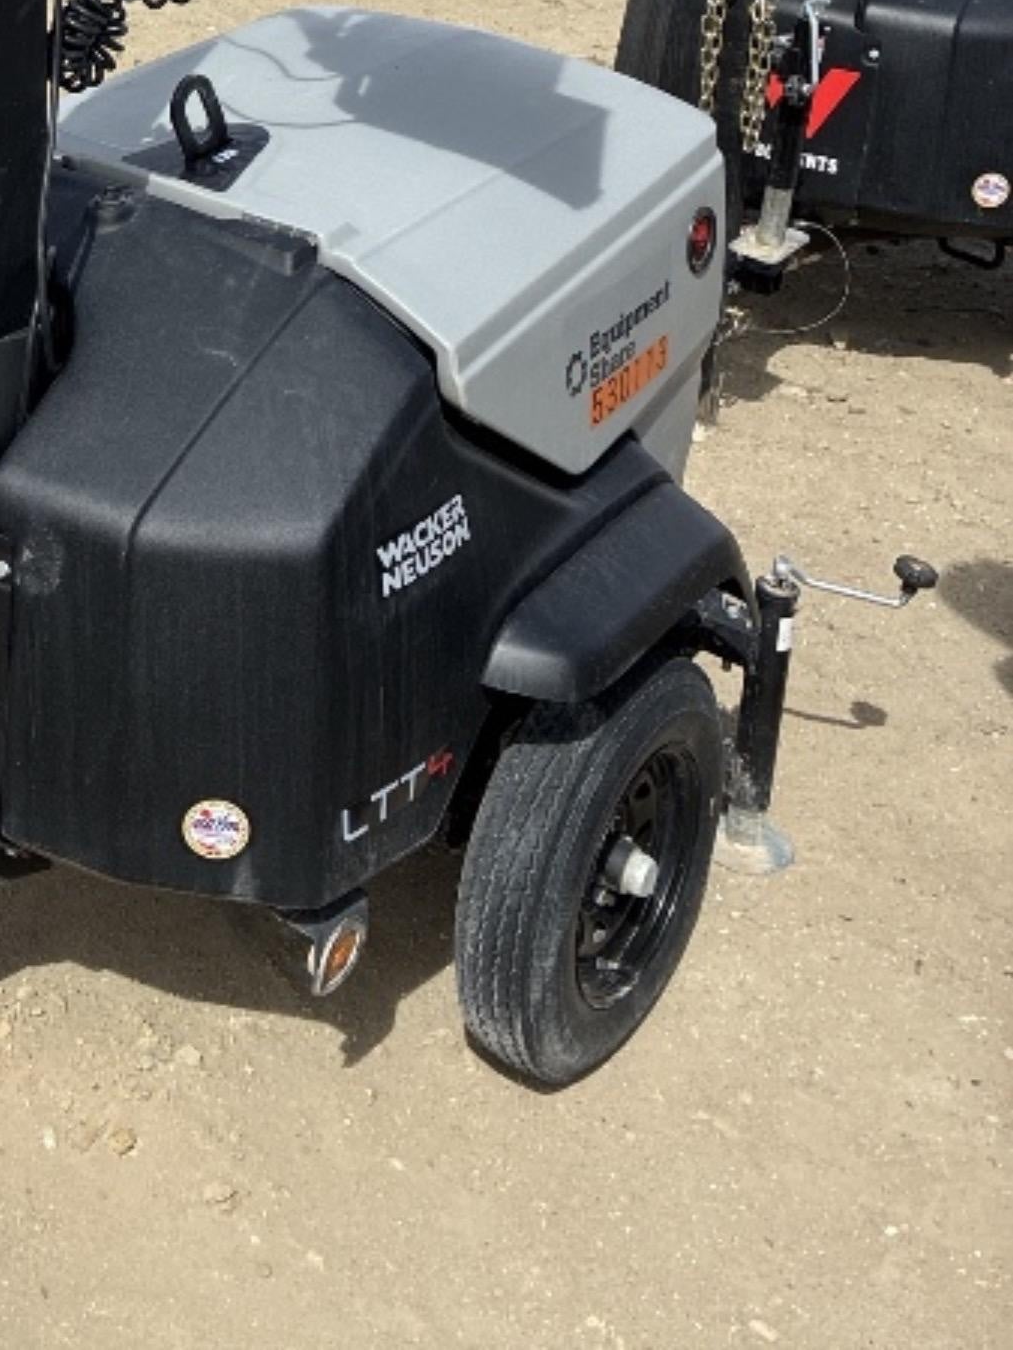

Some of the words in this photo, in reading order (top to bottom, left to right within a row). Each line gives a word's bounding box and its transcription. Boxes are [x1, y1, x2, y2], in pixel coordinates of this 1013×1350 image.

[589, 280, 670, 359] Equipment
[590, 340, 637, 388] Share
[592, 335, 669, 425] 530113
[376, 494, 465, 568] WACKER
[382, 516, 471, 598] NEUSON
